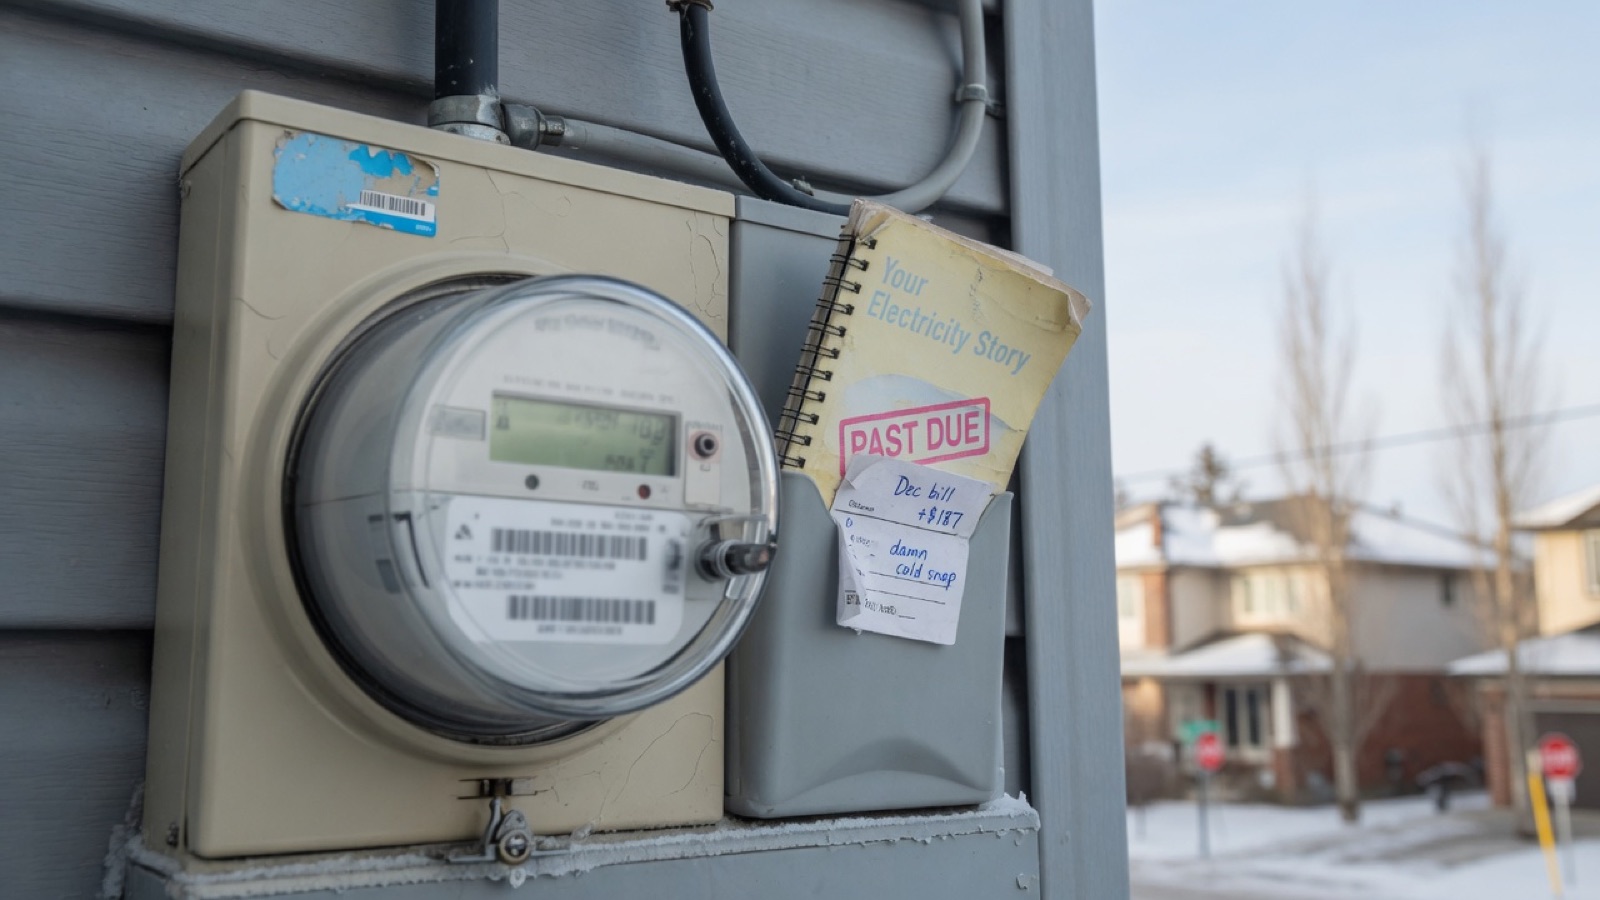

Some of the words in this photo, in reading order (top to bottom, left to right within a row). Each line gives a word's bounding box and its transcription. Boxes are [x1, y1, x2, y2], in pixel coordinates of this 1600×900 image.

[882, 256, 928, 297] Your
[867, 289, 972, 355] Electricity
[973, 330, 1031, 376] Story
[850, 421, 918, 458] PAST
[926, 411, 980, 451] DUE
[894, 475, 921, 497] Dec
[928, 483, 955, 501] bill
[918, 506, 964, 530] +$187
[889, 538, 928, 560] damn
[895, 563, 923, 579] cold
[928, 569, 957, 590] snap
